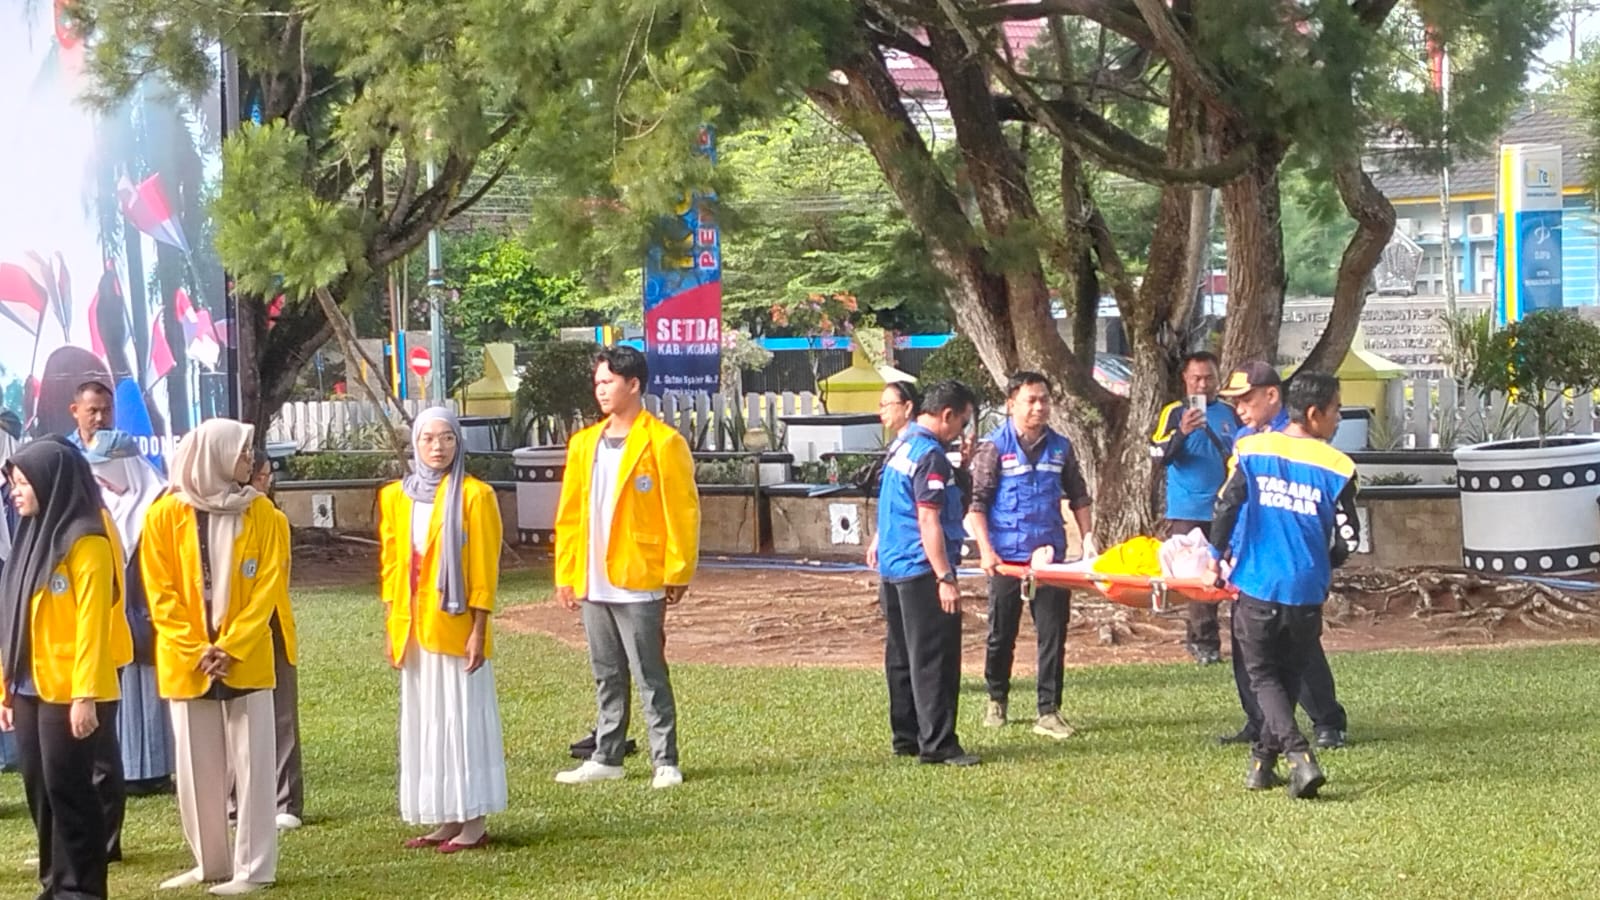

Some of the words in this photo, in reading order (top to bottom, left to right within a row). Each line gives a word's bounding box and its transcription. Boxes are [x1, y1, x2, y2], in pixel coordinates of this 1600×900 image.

[656, 318, 719, 341] SETDA
[658, 343, 683, 355] KAB.
[687, 343, 718, 355] KOBAR
